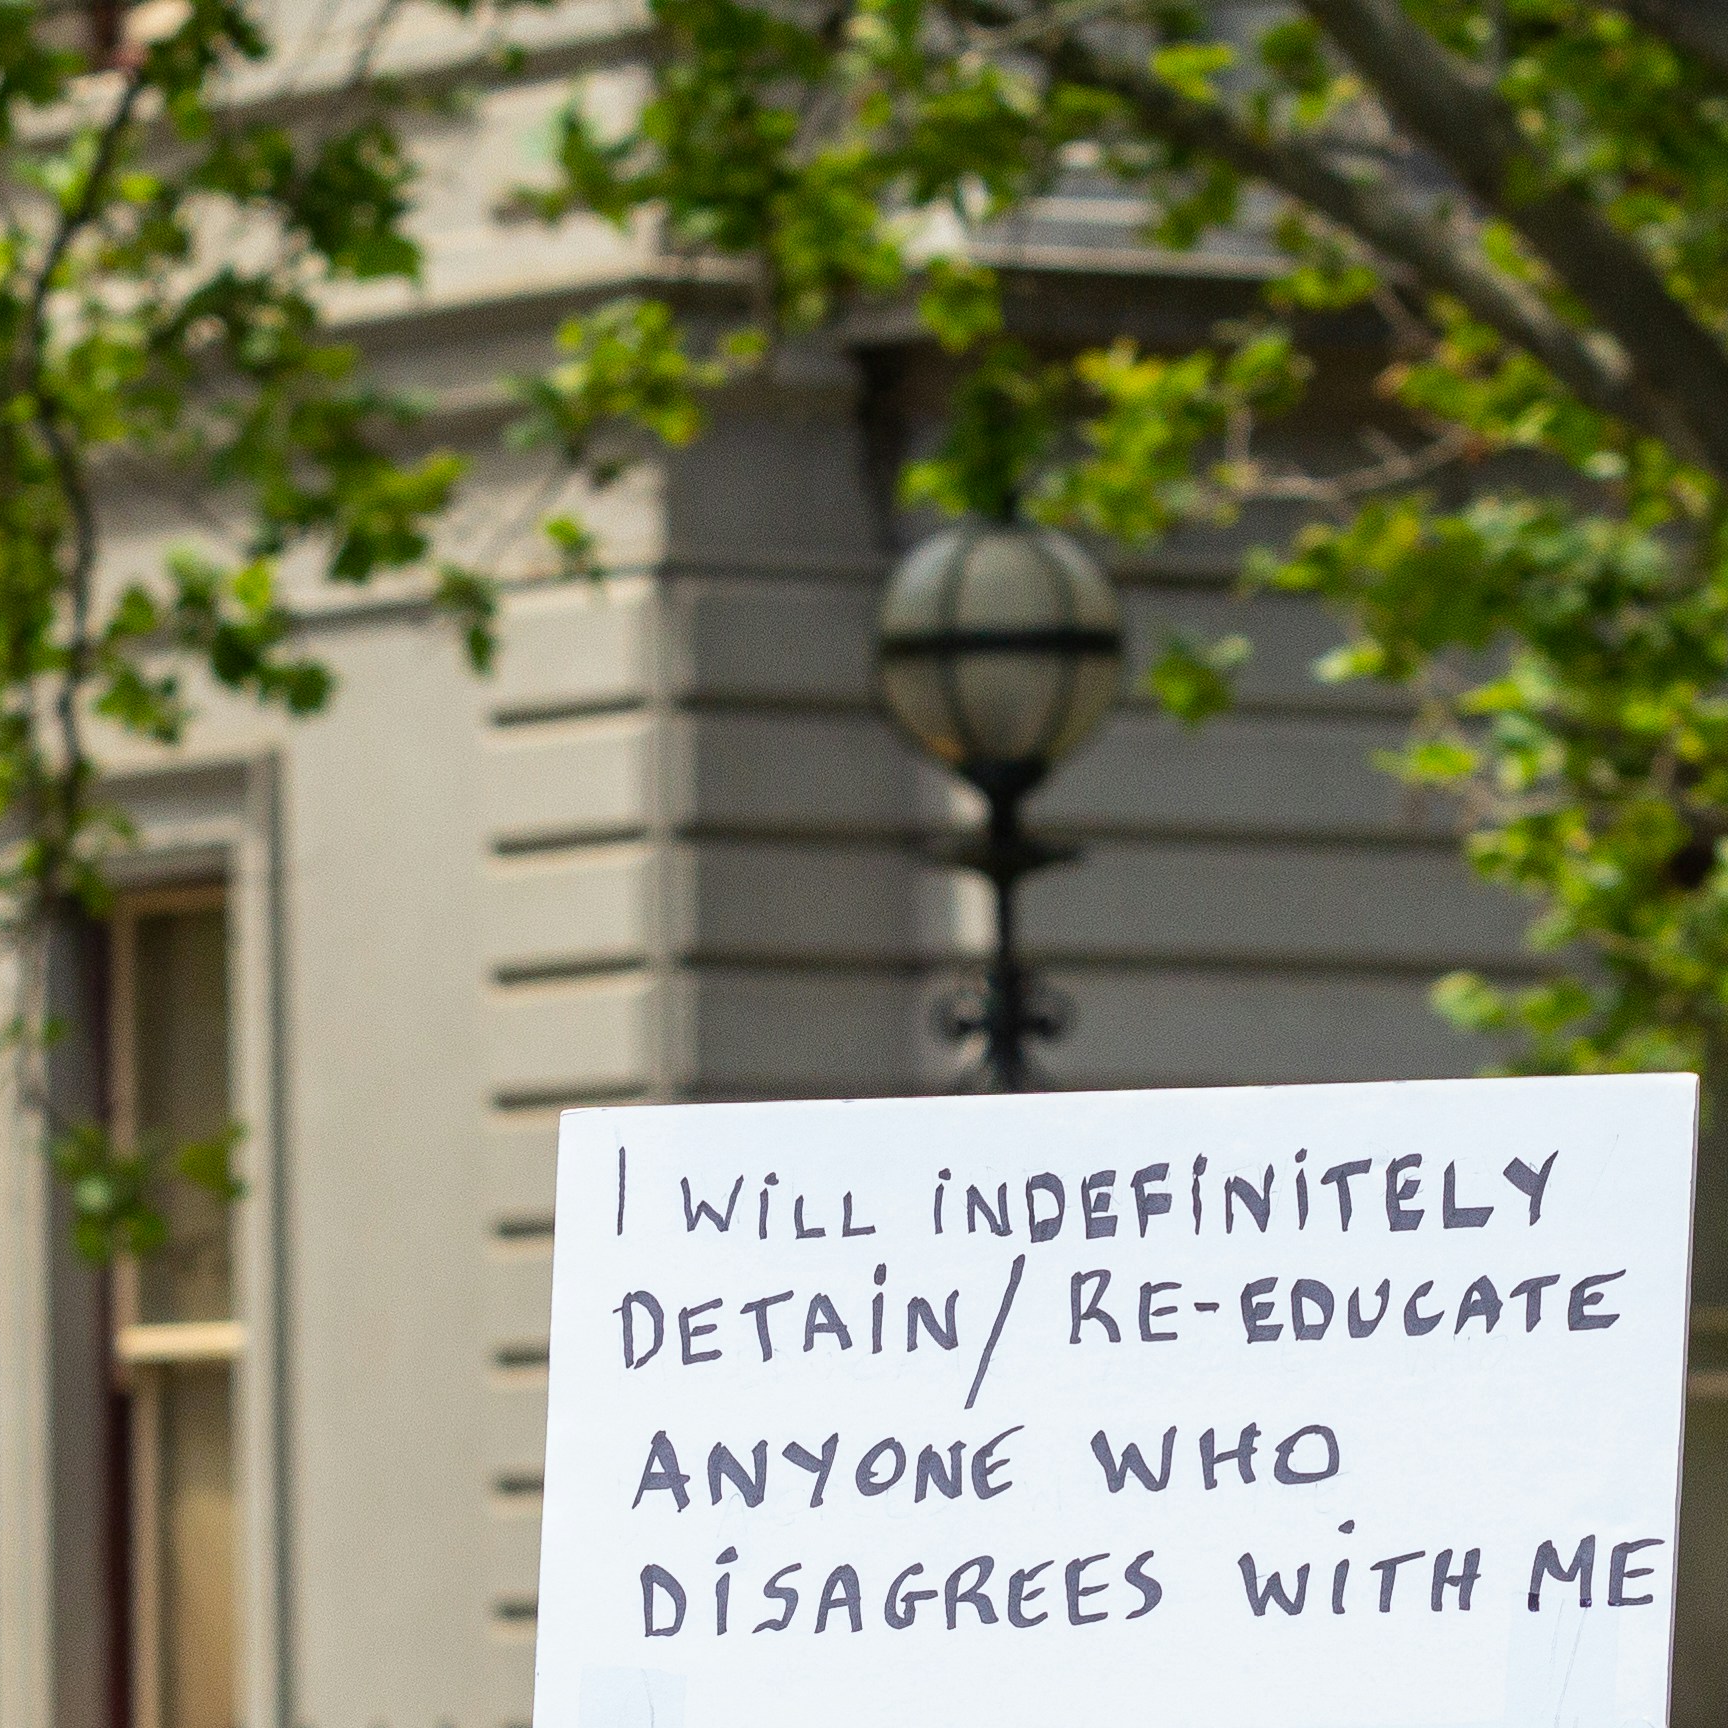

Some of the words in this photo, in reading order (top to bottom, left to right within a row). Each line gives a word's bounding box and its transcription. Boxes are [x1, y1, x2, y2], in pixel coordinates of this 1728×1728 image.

[615, 1145, 628, 1238] I
[1067, 1267, 1628, 1346] RE-EDUCATE
[630, 1423, 1026, 1515] ANYONE
[1088, 1420, 1342, 1495] WHO
[1526, 1533, 1664, 1614] ME
